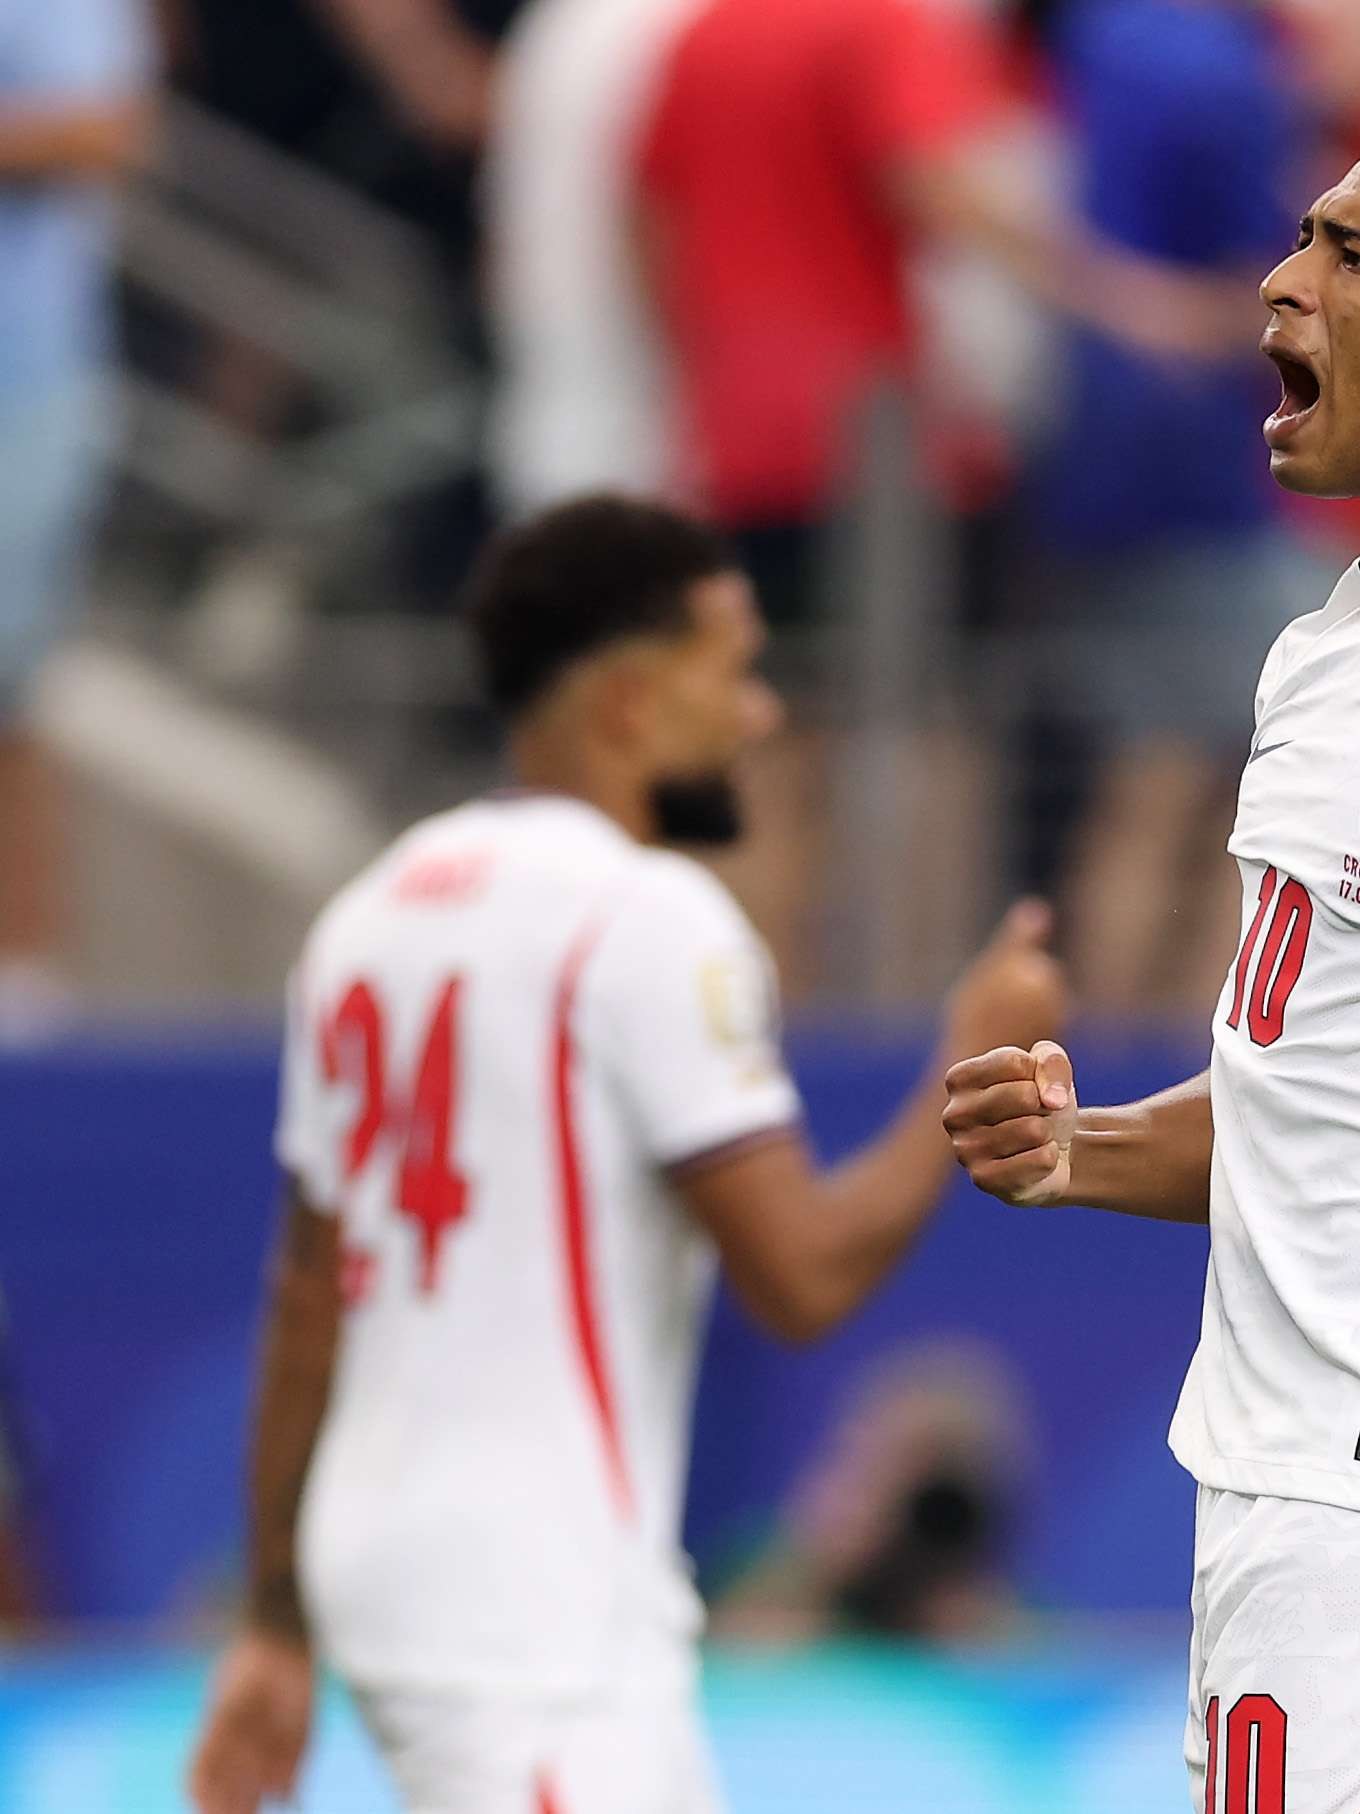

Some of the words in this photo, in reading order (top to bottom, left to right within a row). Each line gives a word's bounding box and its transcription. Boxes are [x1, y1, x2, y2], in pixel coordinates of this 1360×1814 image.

[1226, 864, 1313, 1048] 10
[316, 968, 474, 1308] 24
[1204, 1693, 1288, 1814] 10
